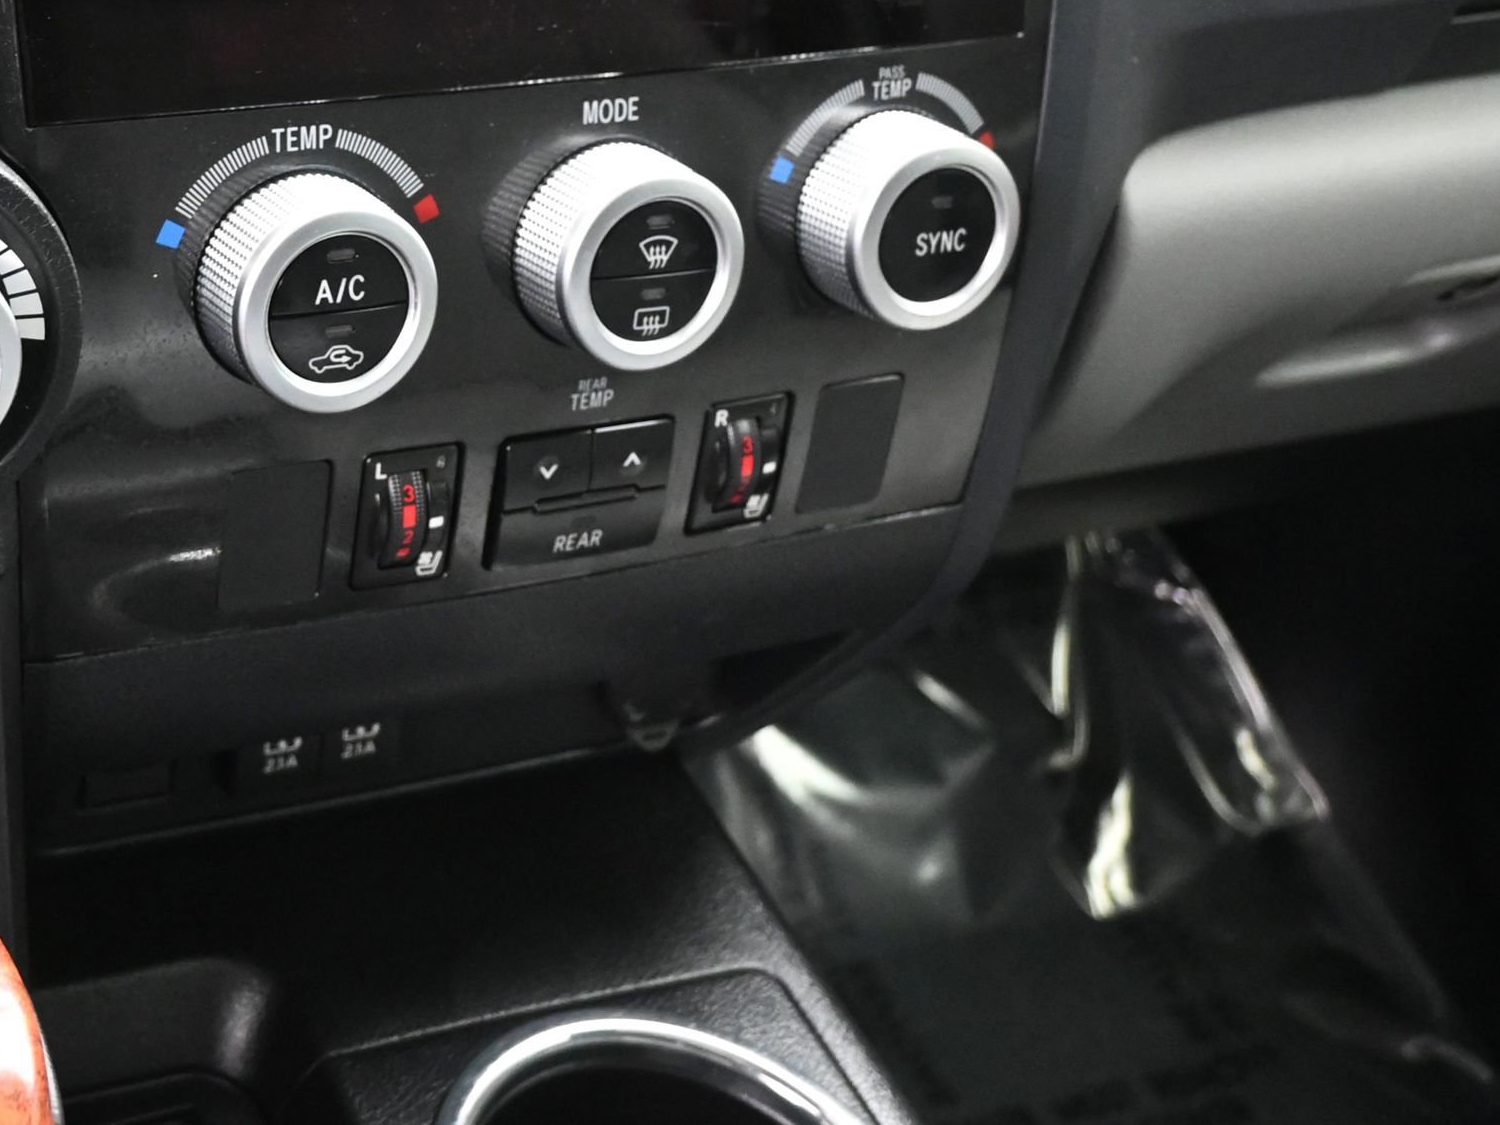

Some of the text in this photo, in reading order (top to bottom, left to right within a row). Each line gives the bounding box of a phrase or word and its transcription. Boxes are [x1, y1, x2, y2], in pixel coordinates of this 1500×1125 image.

[871, 78, 912, 101] TEMP
[582, 96, 640, 125] MODE
[271, 124, 333, 153] TEMP
[915, 228, 967, 257] SYNC
[315, 275, 366, 305] A/C
[570, 389, 615, 412] TEMP
[715, 409, 729, 427] R
[374, 462, 388, 480] L
[403, 484, 416, 503] 3
[553, 529, 603, 554] REAR
